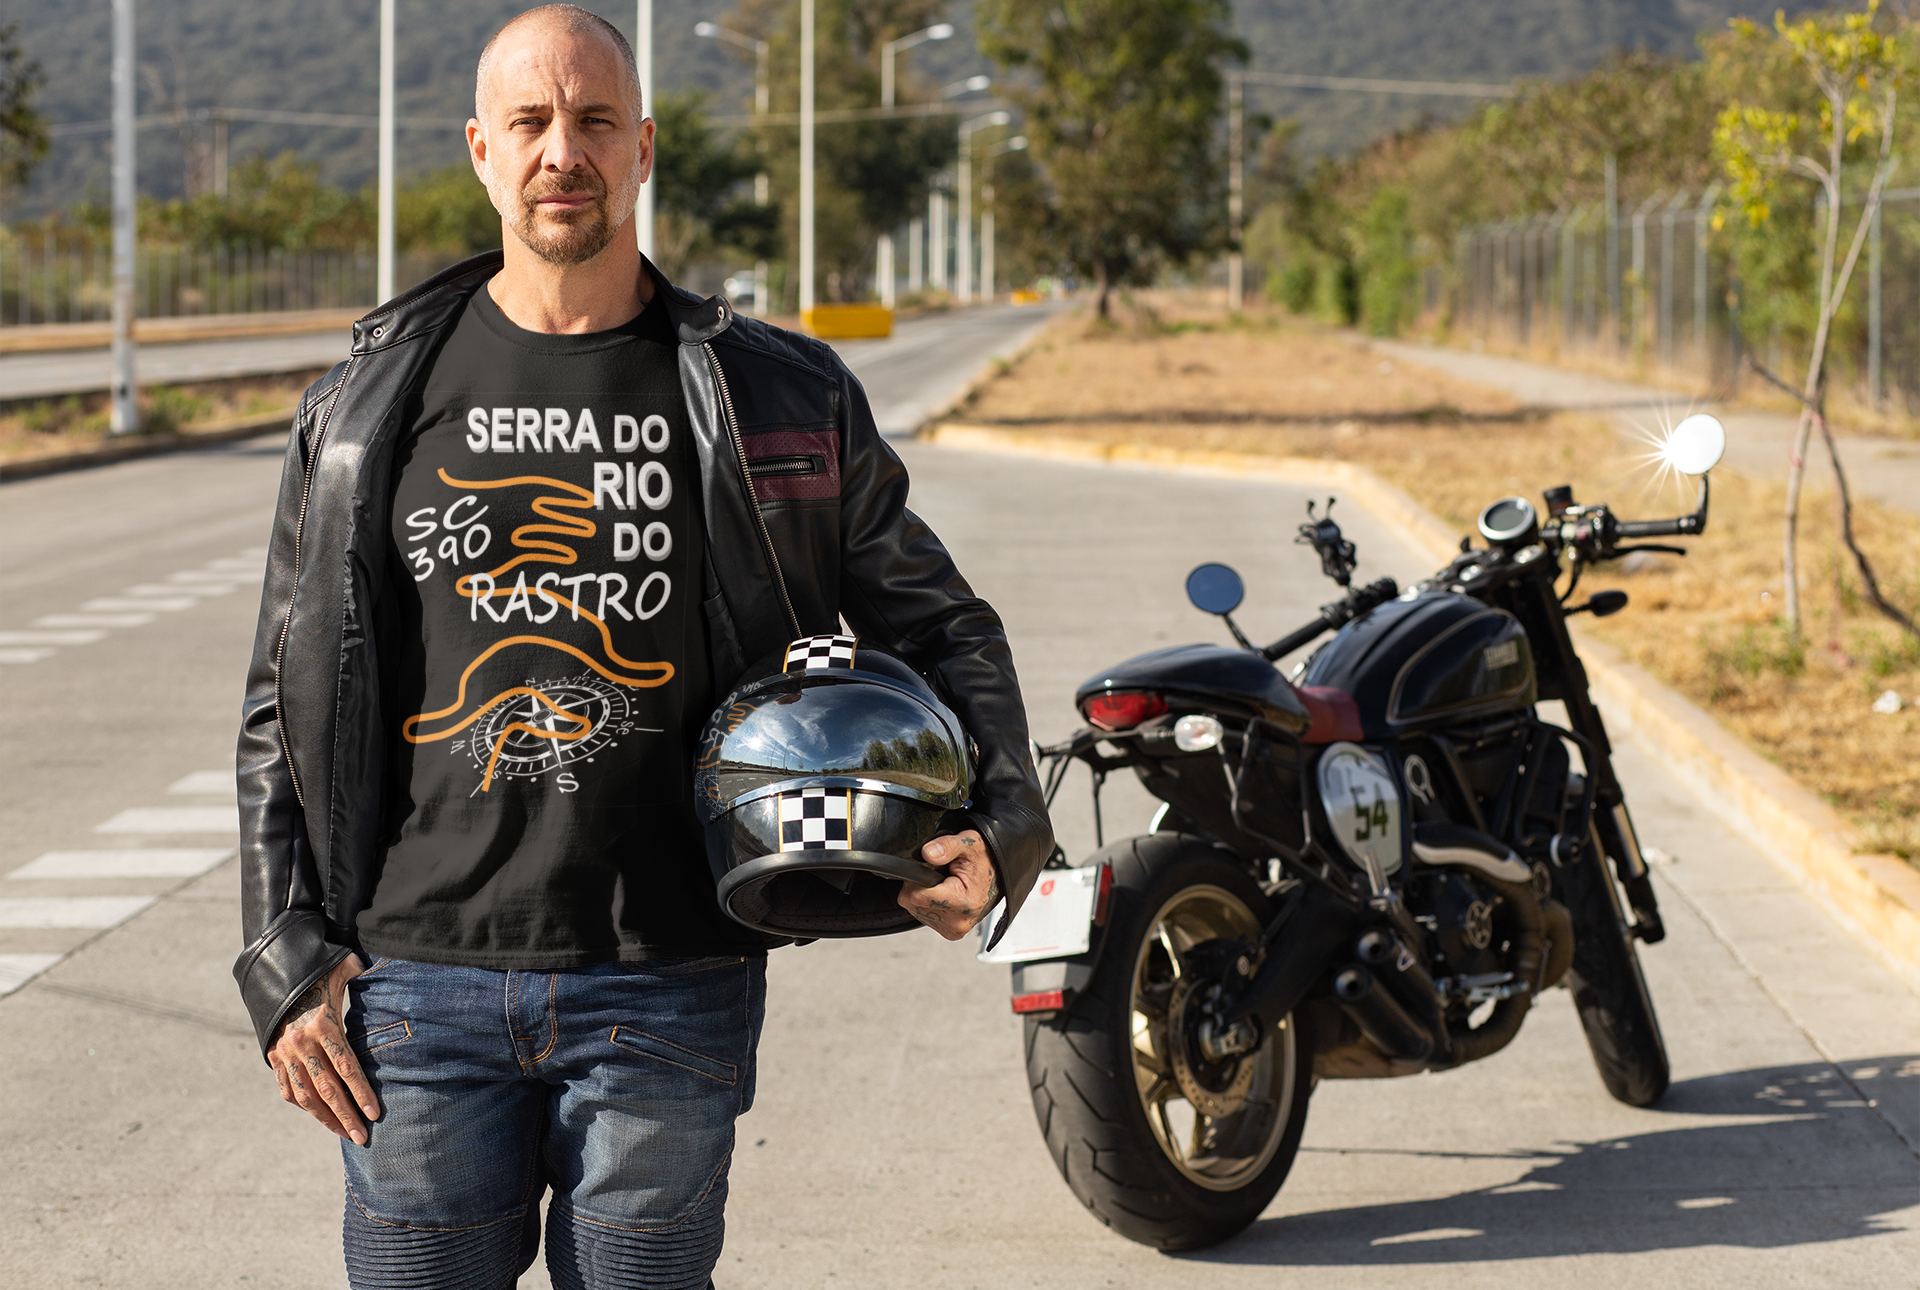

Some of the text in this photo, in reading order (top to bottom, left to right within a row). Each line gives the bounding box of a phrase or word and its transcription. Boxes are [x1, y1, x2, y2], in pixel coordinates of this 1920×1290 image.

[466, 406, 670, 453] SERRA DO
[593, 460, 673, 510] RIO
[405, 495, 489, 541] SC
[613, 521, 673, 562] DO
[407, 523, 492, 582] 390
[468, 570, 672, 624] RASTRO
[556, 772, 580, 794] S
[1350, 782, 1389, 842] 54
